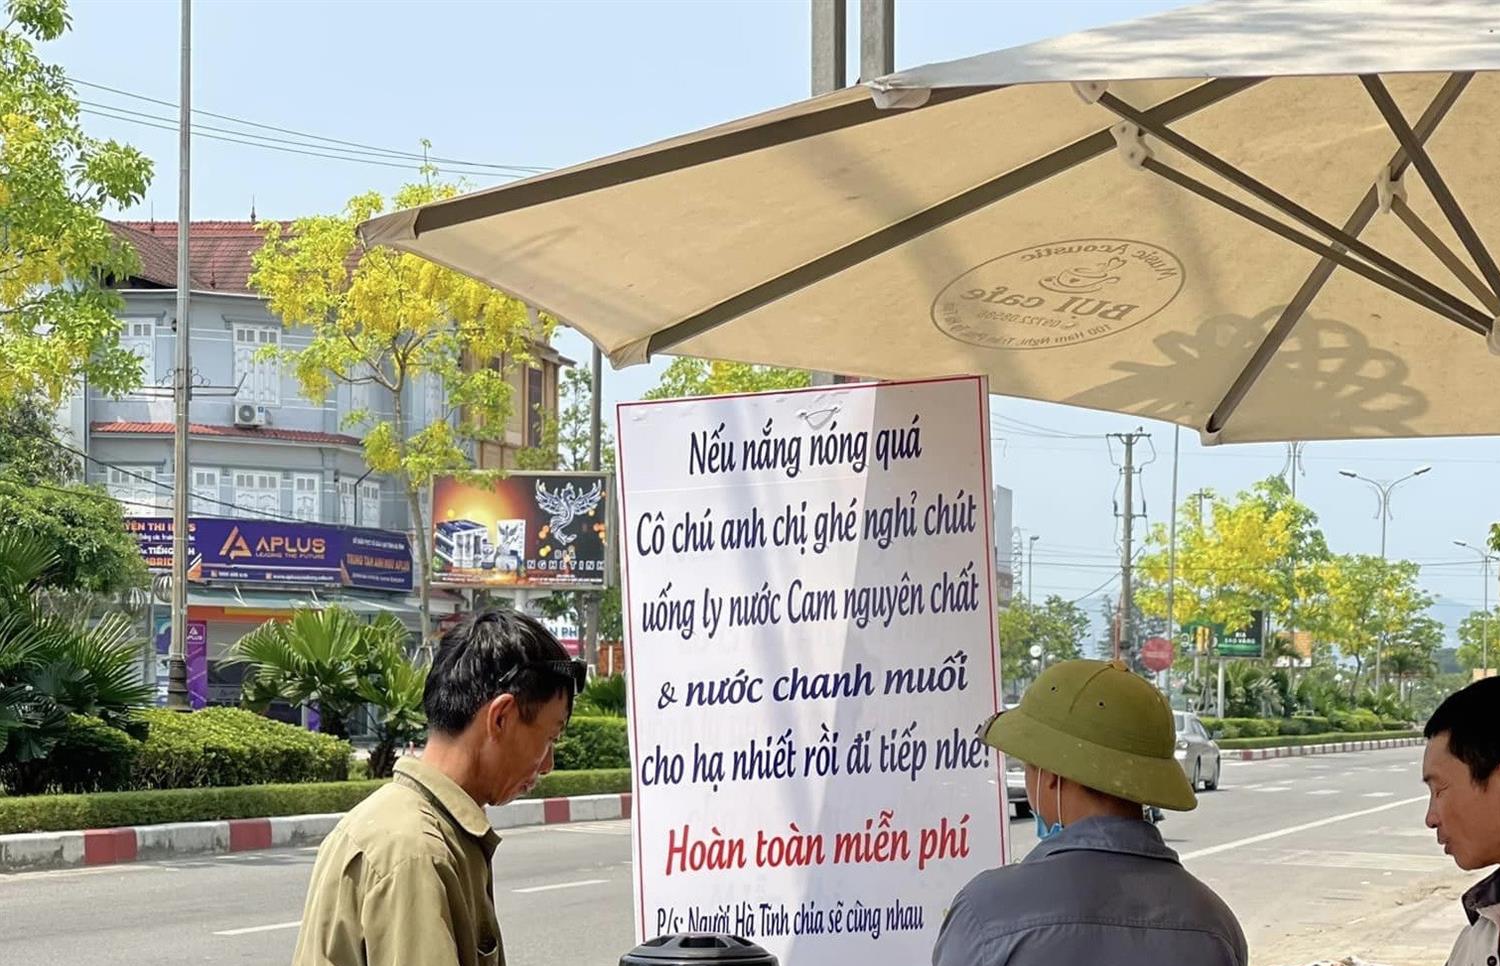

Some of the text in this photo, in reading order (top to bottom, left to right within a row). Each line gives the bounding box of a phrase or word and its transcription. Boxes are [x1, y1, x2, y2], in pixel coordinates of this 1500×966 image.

[689, 414, 922, 478] Nếu nắng nóng quá
[255, 537, 326, 553] APLUS
[636, 489, 976, 556] Cô chú anh chị ghé nghỉ chút
[642, 561, 980, 640] uống ly nước Cam nguyên chất
[657, 650, 968, 709] & nước chanh muối
[641, 745, 684, 786] cho
[692, 743, 725, 792] hạ
[804, 722, 838, 777] rồi
[846, 730, 872, 775] đi
[880, 721, 926, 781] tiếp
[665, 809, 971, 876] Hoàn toàn miễn phí
[735, 901, 755, 937] Hà
[793, 901, 824, 935] chia
[827, 901, 843, 933] sẽ
[846, 900, 881, 940] cùng
[885, 898, 925, 931] nhau
